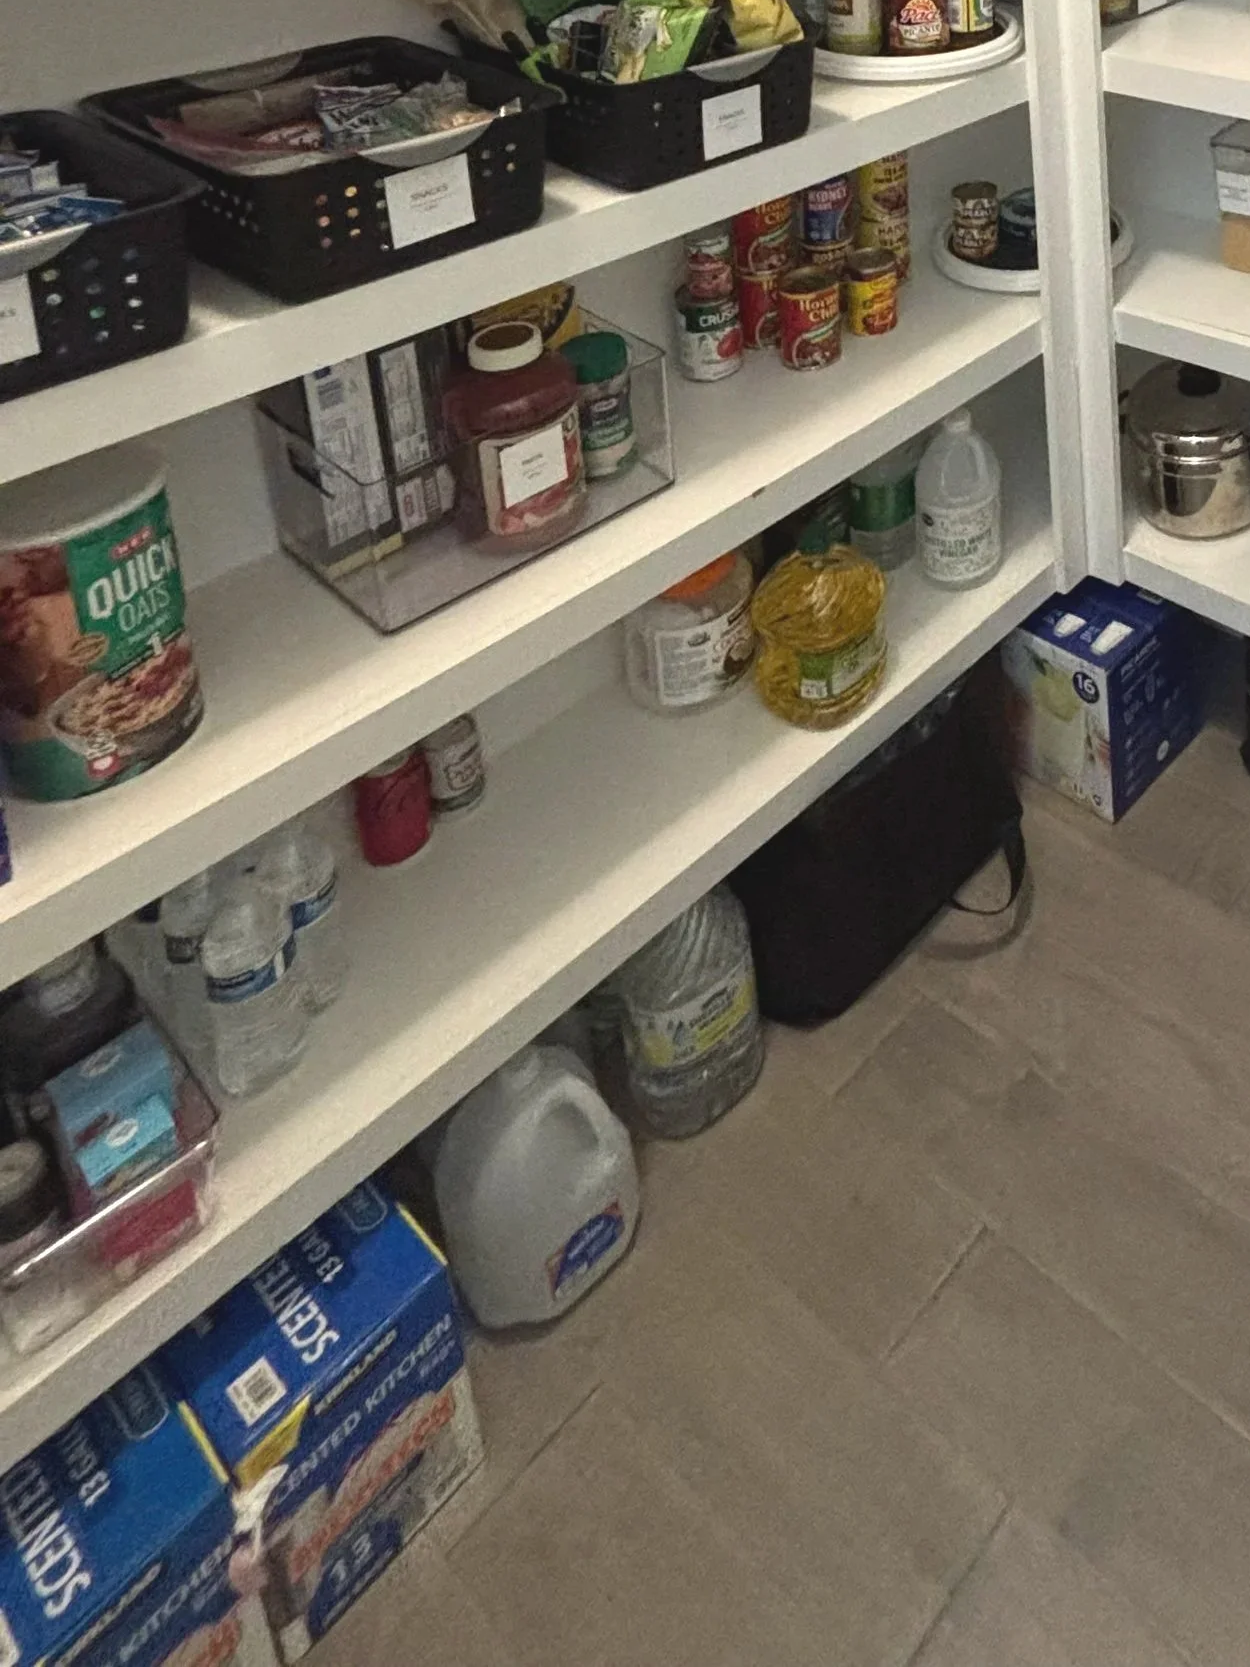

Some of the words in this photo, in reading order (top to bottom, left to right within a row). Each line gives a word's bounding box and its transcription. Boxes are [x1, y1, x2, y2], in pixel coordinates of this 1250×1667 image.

[87, 537, 177, 620] QUICK
[117, 586, 171, 632] OATS
[1074, 671, 1096, 696] 16
[249, 1254, 341, 1365] SCENTE
[364, 1312, 452, 1415] KITCHEN
[2, 1458, 92, 1619] SCENTED
